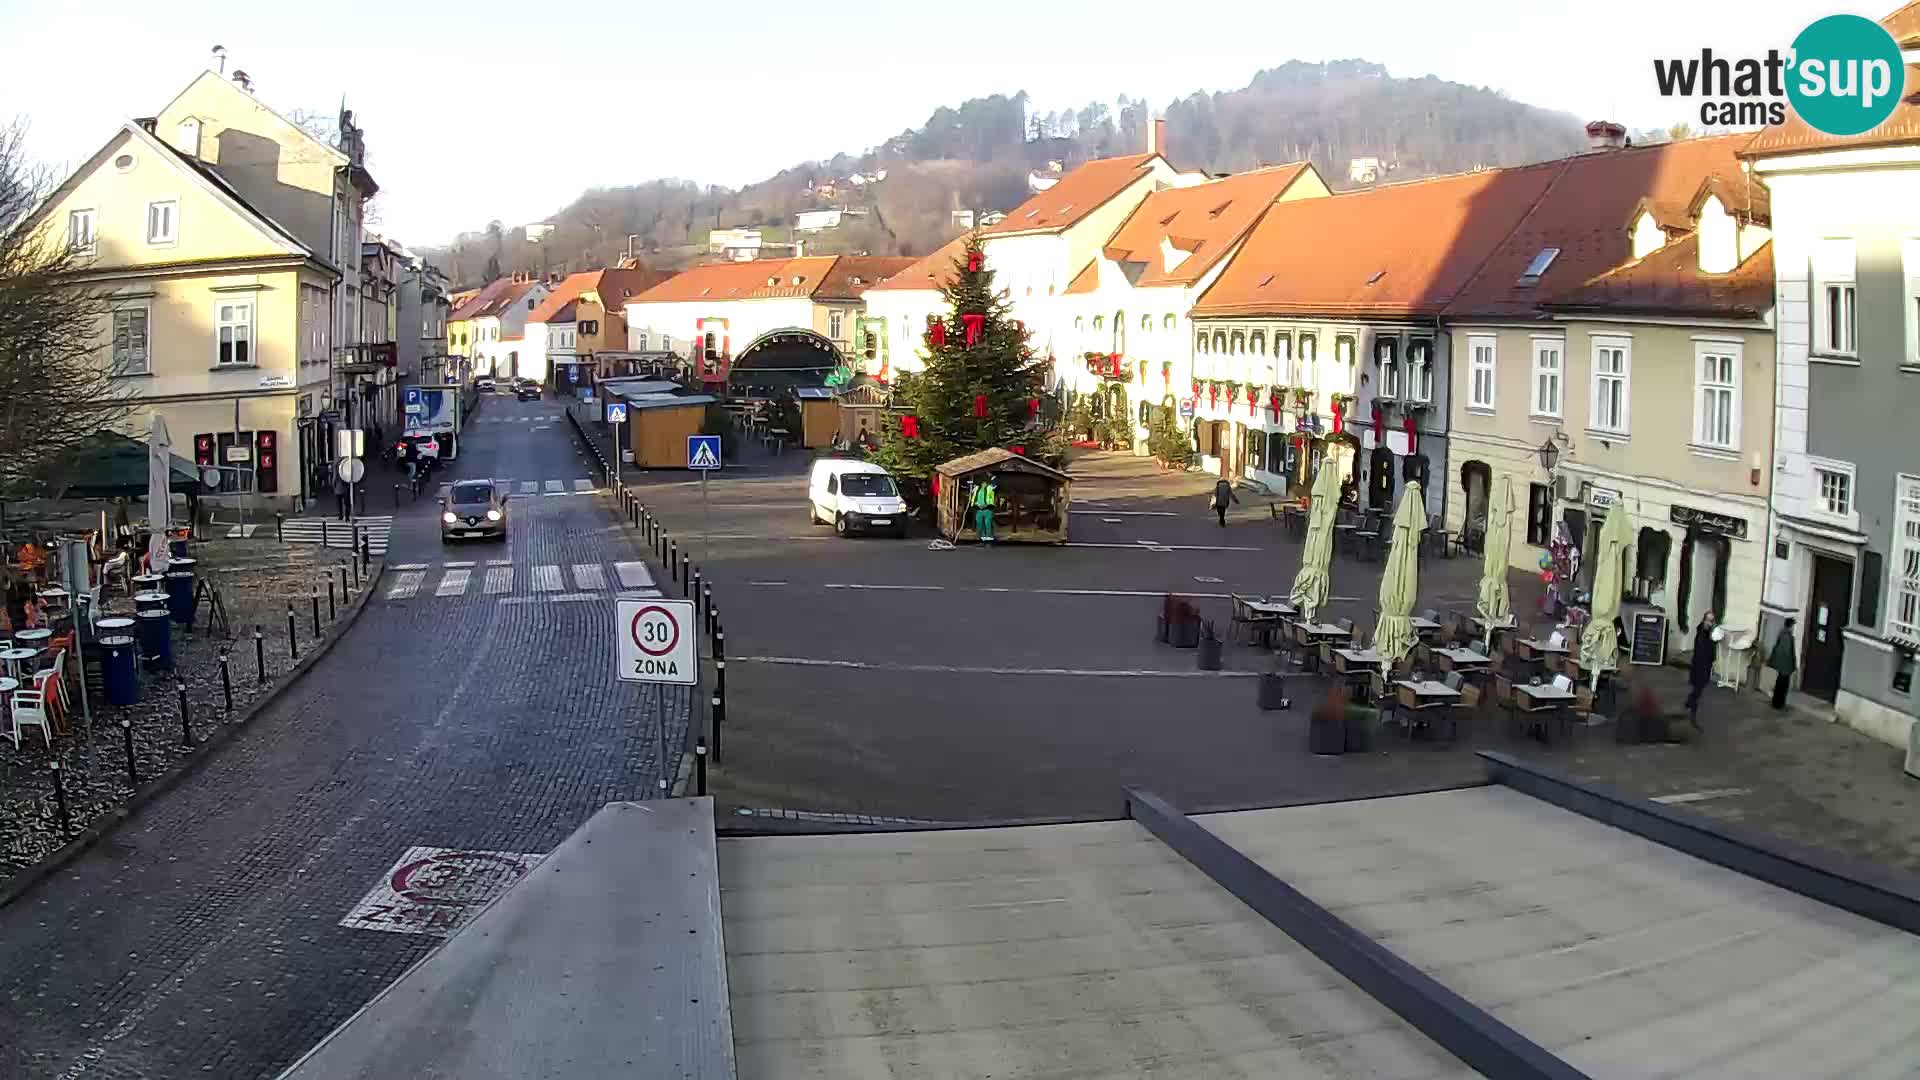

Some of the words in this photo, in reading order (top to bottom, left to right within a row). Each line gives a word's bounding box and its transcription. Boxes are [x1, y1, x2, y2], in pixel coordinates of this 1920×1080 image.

[408, 391, 417, 402] P
[644, 621, 668, 643] 30
[634, 659, 679, 675] ZONA
